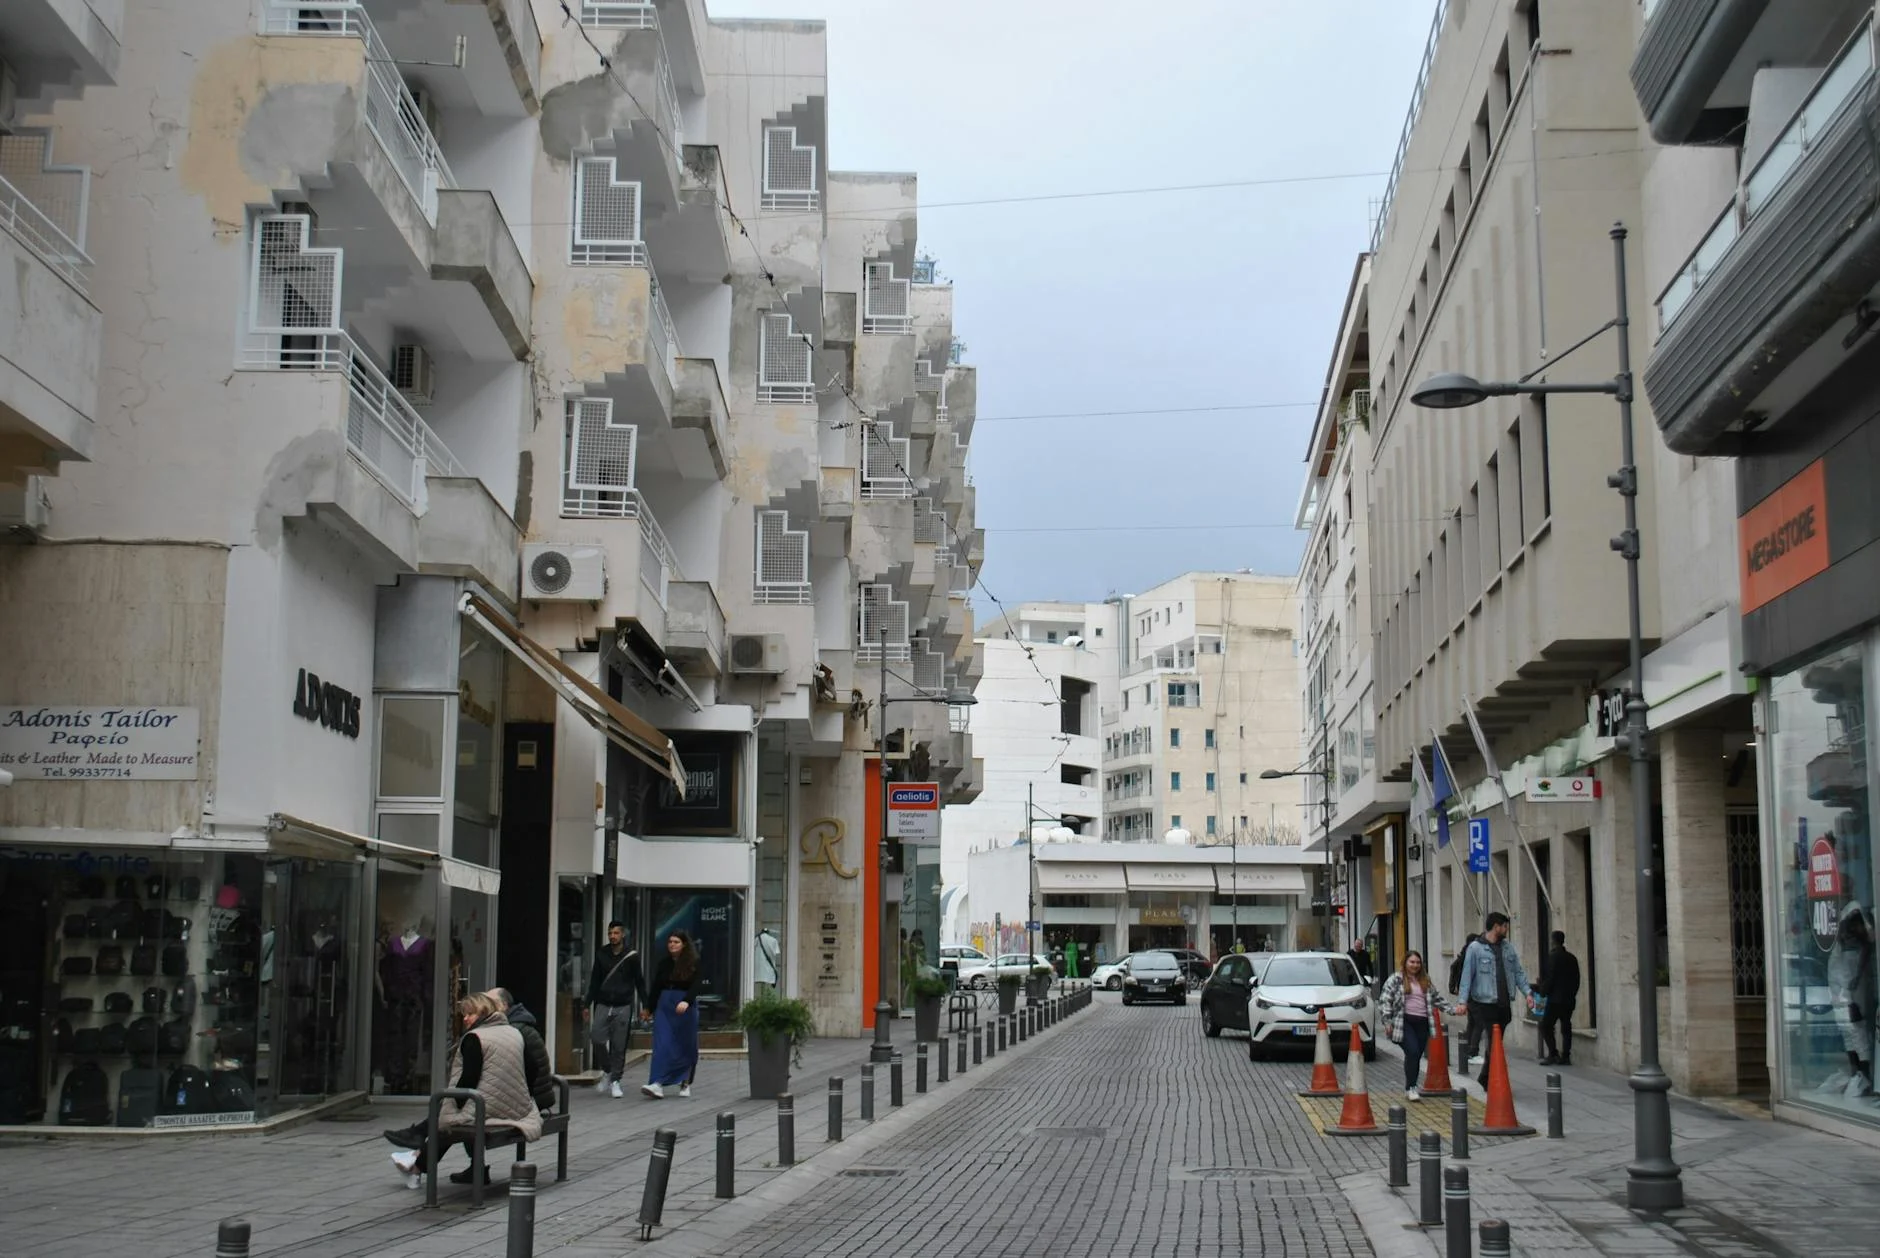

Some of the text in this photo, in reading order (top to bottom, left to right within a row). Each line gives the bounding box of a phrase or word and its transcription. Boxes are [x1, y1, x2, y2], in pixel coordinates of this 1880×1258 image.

[1747, 505, 1815, 576] MEGASTORE
[293, 667, 361, 739] ADONIS
[2, 708, 178, 727] Adonis Tailor
[48, 731, 129, 748] Ραφείο
[0, 752, 194, 764] its & Leather Made to Measure
[42, 767, 131, 778] Tel. 99337714
[896, 792, 930, 801] aeliotis
[802, 817, 859, 879] R
[1814, 874, 1832, 892] STOCK
